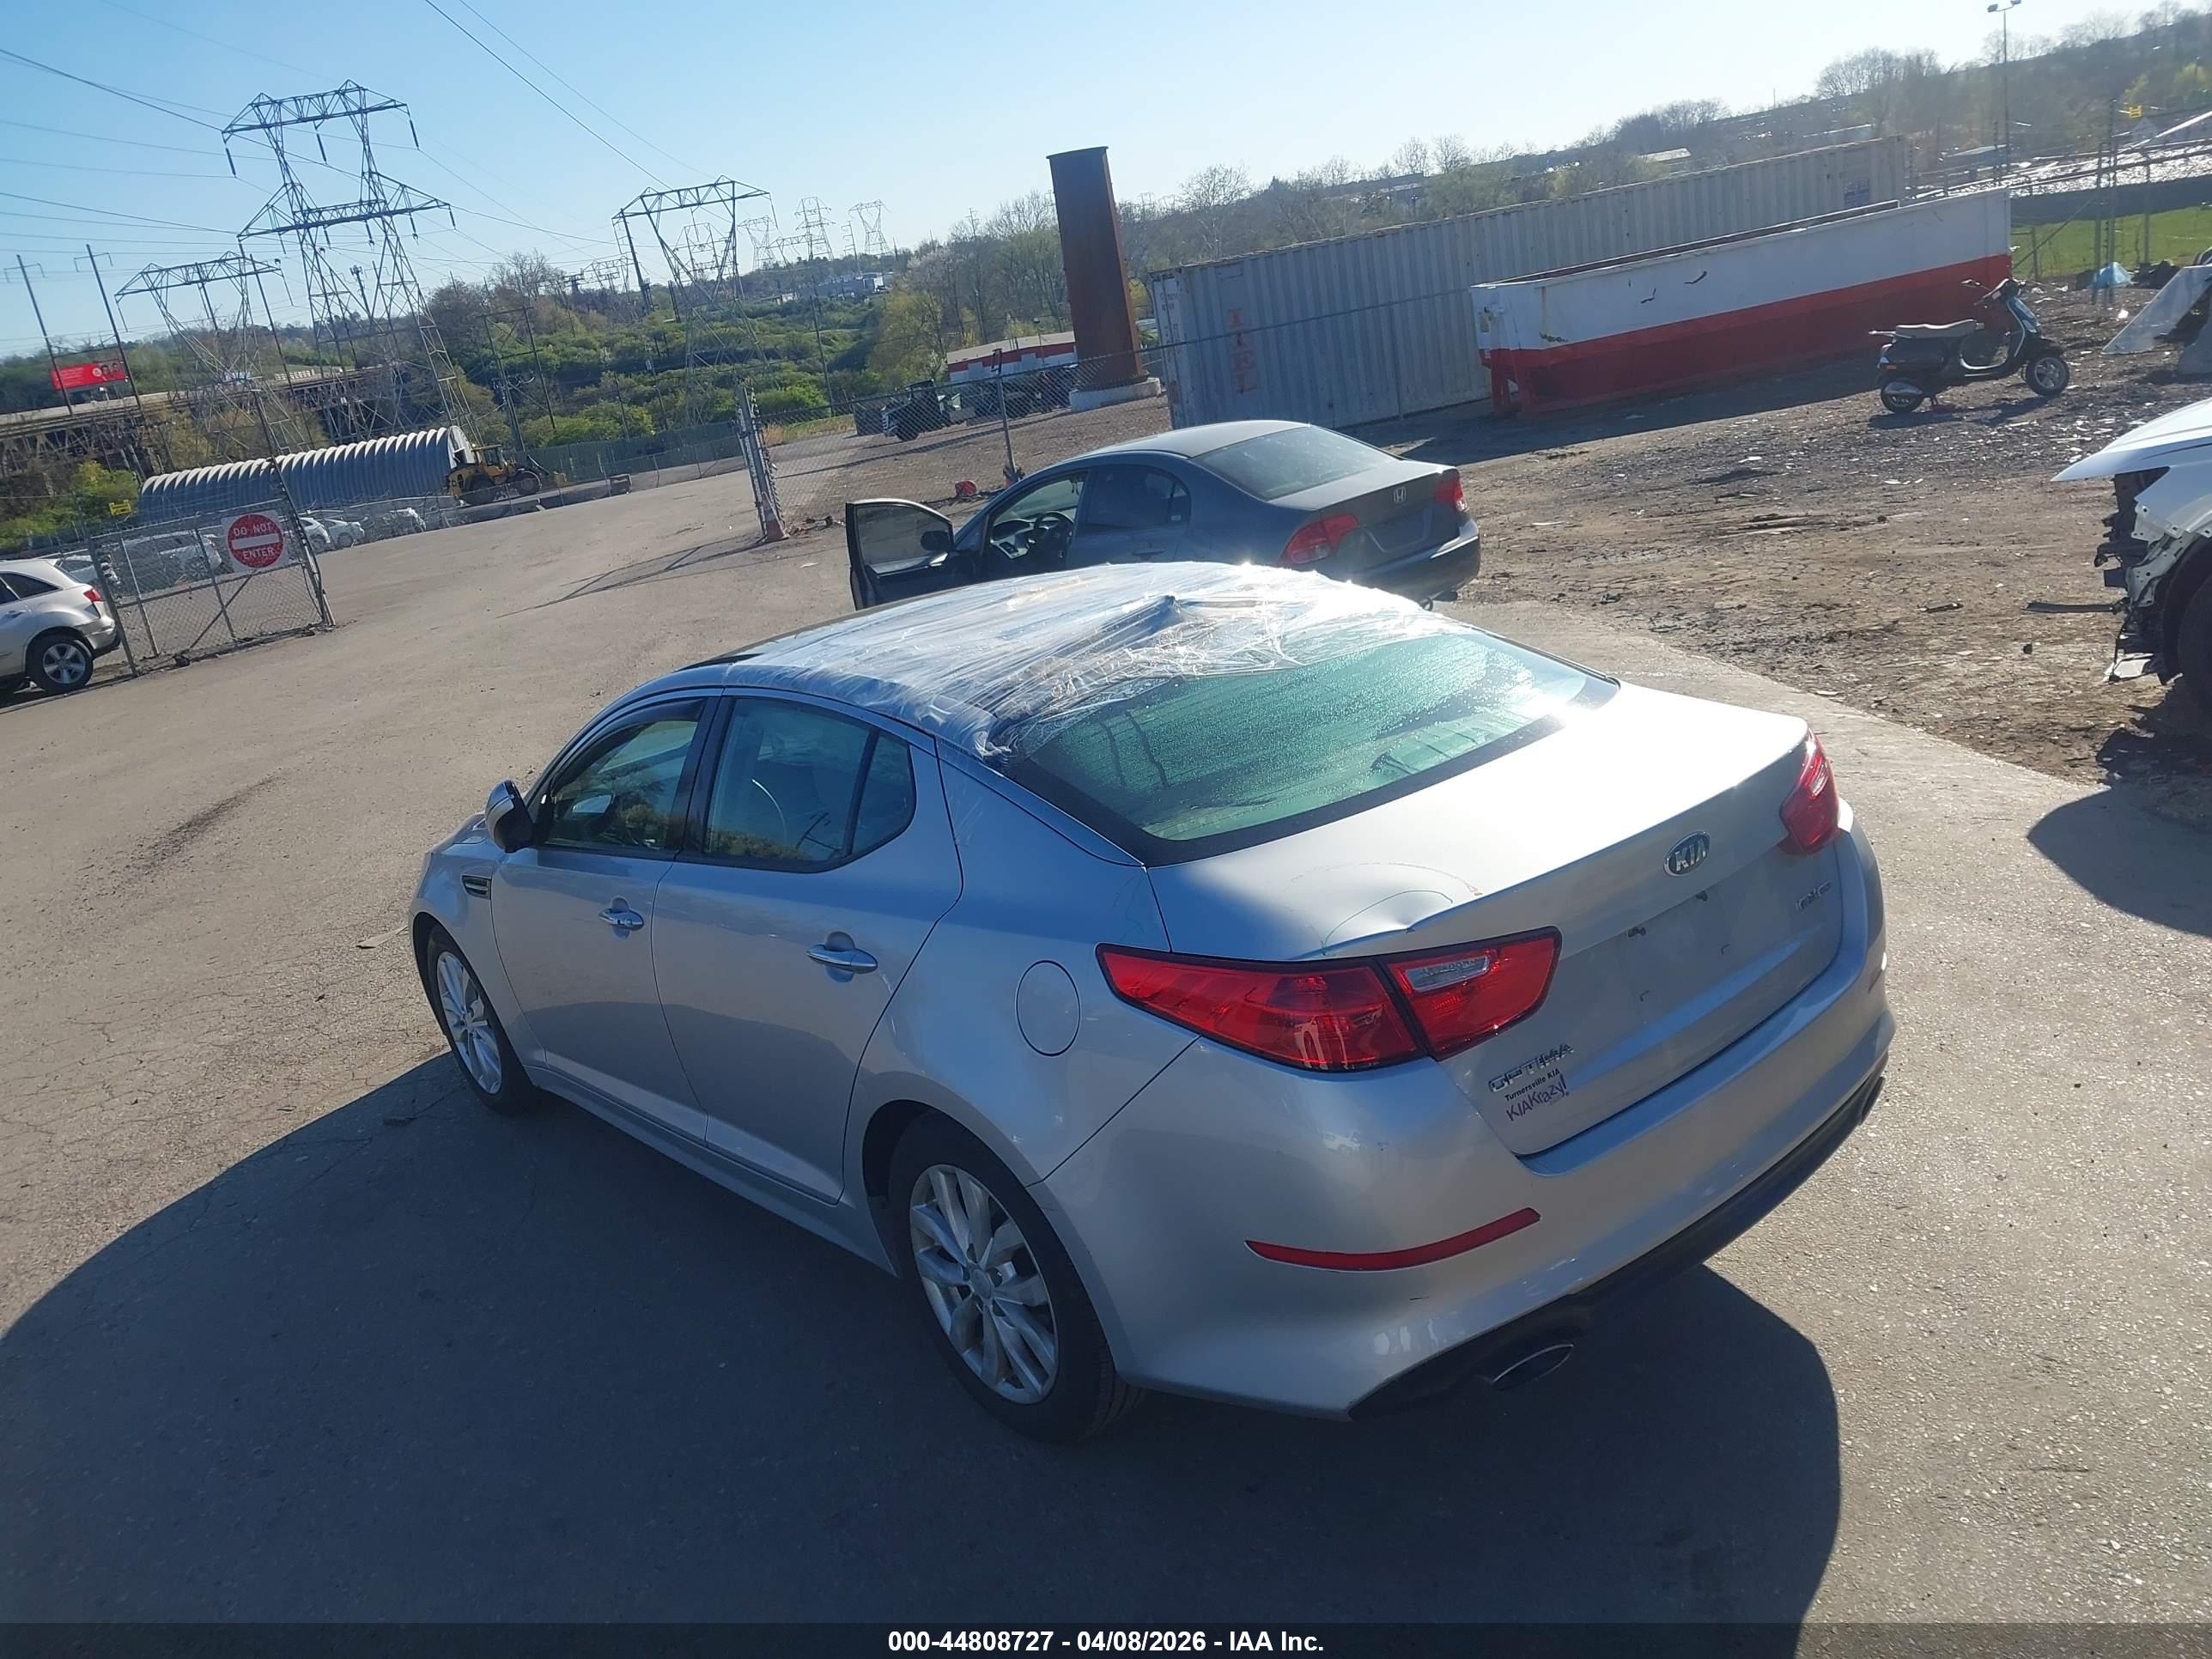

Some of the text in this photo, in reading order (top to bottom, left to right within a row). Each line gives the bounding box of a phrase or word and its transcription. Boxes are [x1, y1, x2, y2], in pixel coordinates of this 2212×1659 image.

[233, 522, 273, 537] DO NOT
[242, 547, 275, 560] ENTER
[1675, 838, 1706, 872] KIA
[1488, 1043, 1573, 1092] OPTIMA
[1504, 1067, 1560, 1101] Turnersville KIA
